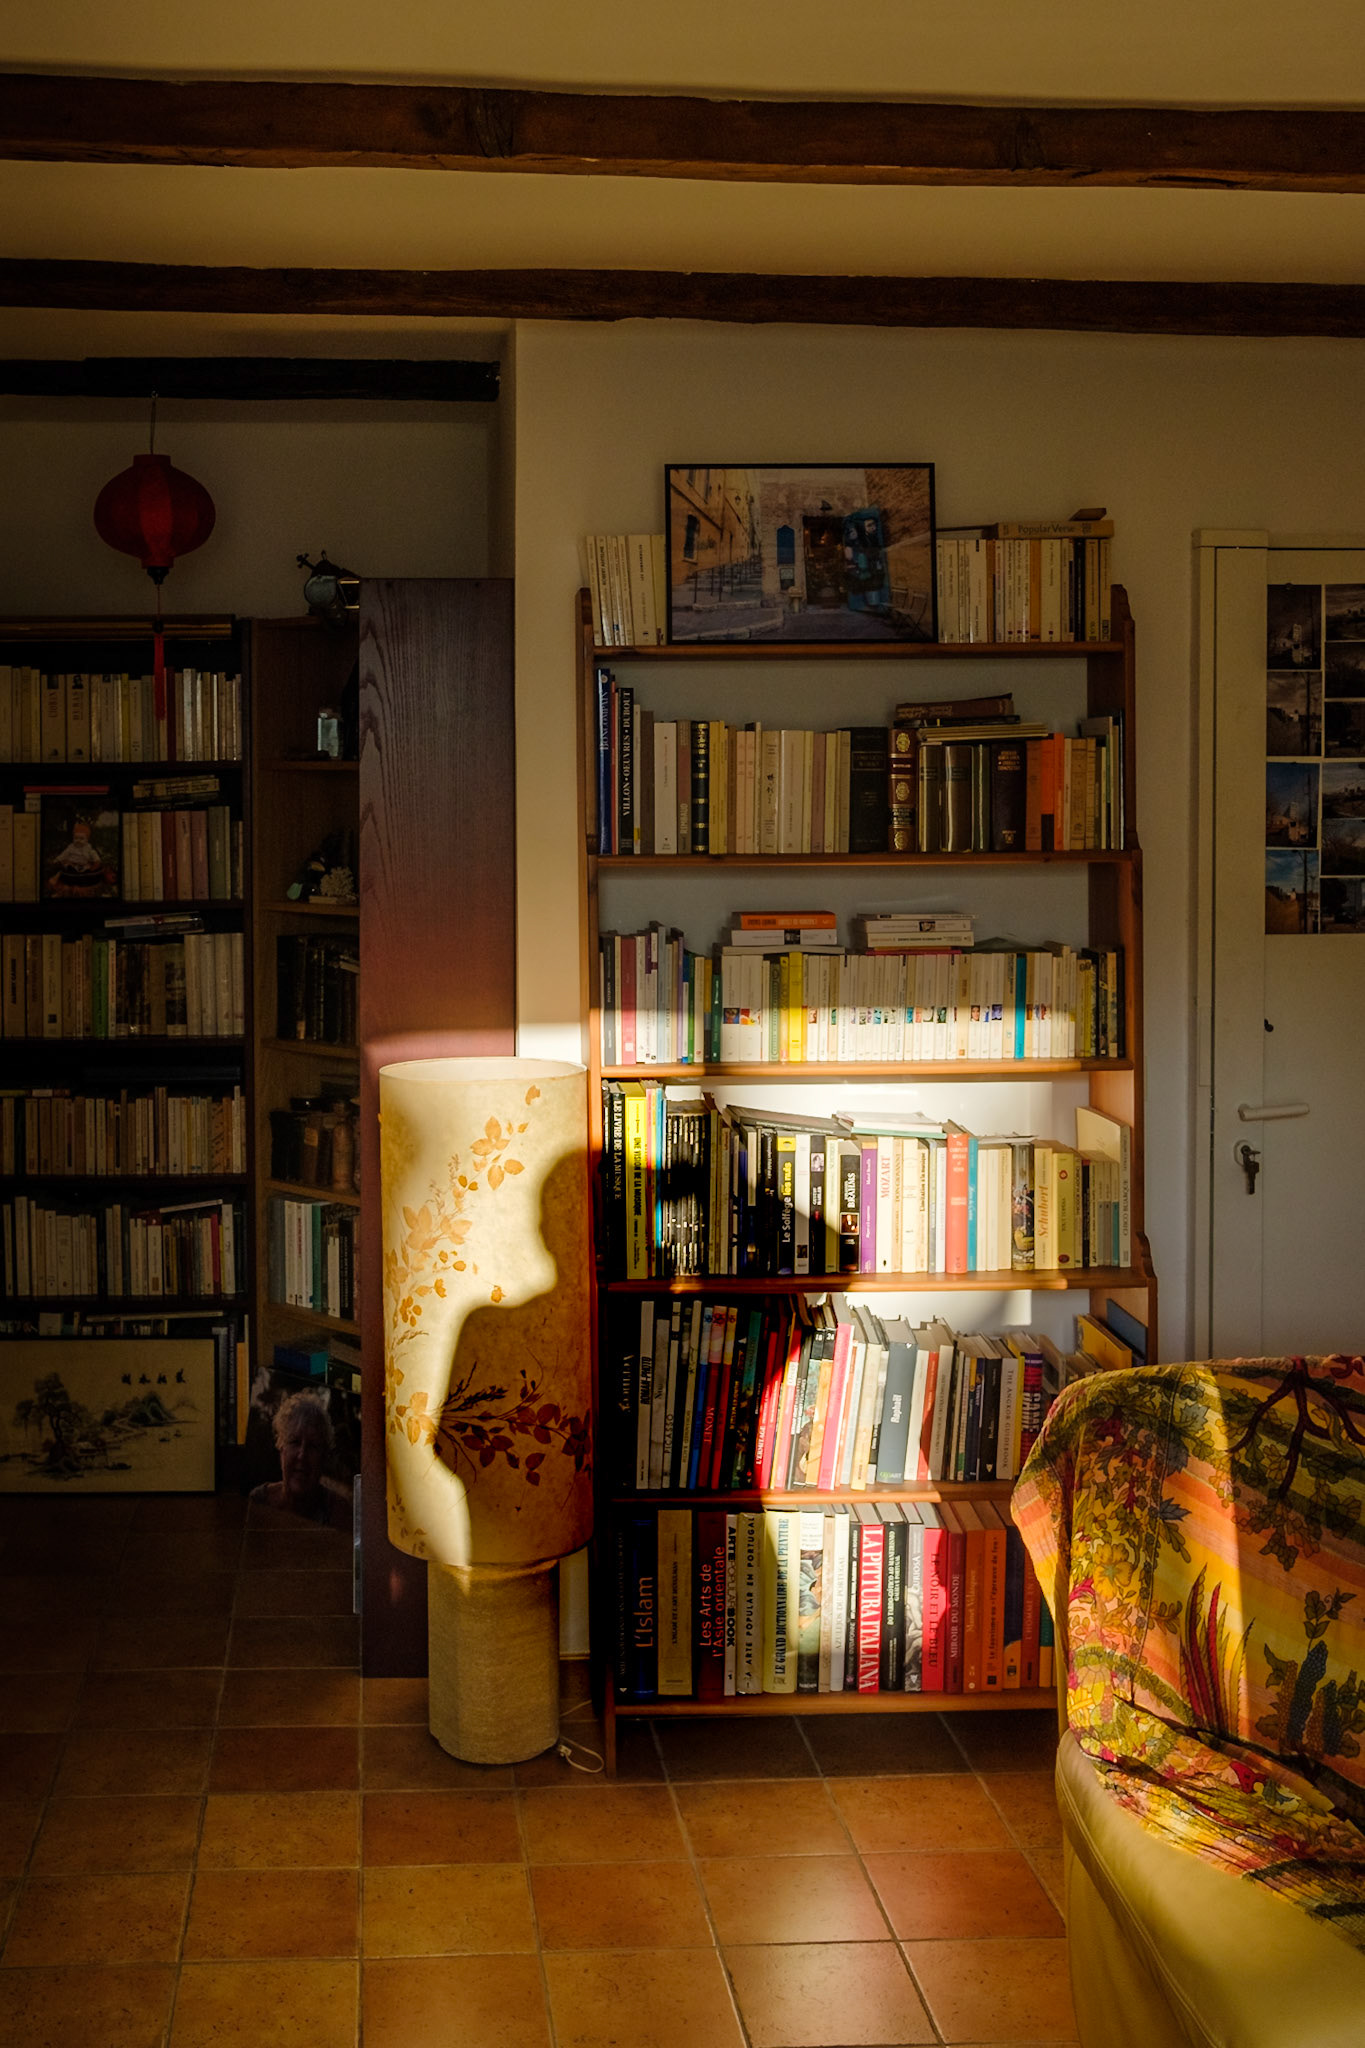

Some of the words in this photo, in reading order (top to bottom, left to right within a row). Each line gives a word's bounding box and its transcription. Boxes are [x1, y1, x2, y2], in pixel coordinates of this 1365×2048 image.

[1018, 525, 1050, 535] Popular
[600, 690, 609, 750] BONCOMPAIN
[622, 691, 632, 728] DUBOUT
[622, 735, 632, 777] OEUVRES
[622, 782, 632, 816] VILLON
[613, 1100, 623, 1112] LE
[613, 1113, 622, 1139] LIVRE
[613, 1139, 622, 1151] DE
[613, 1152, 622, 1163] LA
[633, 1137, 642, 1150] UNE
[633, 1151, 642, 1170] VISION
[633, 1171, 642, 1180] DE
[782, 1162, 791, 1181] nuls
[613, 1164, 622, 1200] MUSIQUE
[633, 1180, 642, 1188] LA
[783, 1181, 791, 1196] les
[846, 1172, 856, 1209] BRAHMS
[880, 1156, 891, 1199] MOZART
[632, 1188, 642, 1216] MUSIQUE
[781, 1196, 793, 1231] Solfège
[1037, 1184, 1049, 1239] Schubert
[782, 1232, 791, 1243] Le
[826, 1332, 835, 1341] 24
[891, 1393, 903, 1424] Raphaël
[1005, 1386, 1013, 1420] ANGKOR
[664, 1414, 673, 1454] PICASSO
[703, 1406, 715, 1446] MONET
[1003, 1422, 1011, 1469] GUIDEBOOK
[727, 1526, 736, 1561] ARTE
[746, 1518, 755, 1568] PORTUGAL
[778, 1518, 789, 1556] PEINTURE
[862, 1527, 883, 1548] LA
[699, 1563, 712, 1582] de
[777, 1559, 788, 1568] LA
[930, 1553, 940, 1564] LE
[712, 1546, 724, 1612] orientale
[747, 1574, 754, 1587] EM
[777, 1570, 787, 1581] DE
[837, 1556, 846, 1597] PORTUGAL
[861, 1551, 883, 1622] PITTURA
[930, 1570, 941, 1599] NOIR
[950, 1573, 960, 1610] MONDE
[632, 1576, 654, 1648] L'Islam
[699, 1585, 712, 1618] Arts
[746, 1592, 754, 1636] POPULAR
[776, 1581, 787, 1635] DICTIONNAIRE
[929, 1605, 940, 1615] ET
[950, 1610, 958, 1623] DU
[699, 1621, 712, 1647] Les
[727, 1608, 735, 1648] BOOK
[835, 1612, 844, 1651] AZULEJOS
[929, 1621, 939, 1633] LE
[988, 1617, 996, 1650] fauvisme
[1025, 1600, 1033, 1641] L'HOMME
[712, 1617, 724, 1658] l'Asie
[775, 1637, 787, 1664] GRAND
[928, 1638, 939, 1668] BLEU
[950, 1624, 959, 1659] MIROIR
[775, 1666, 786, 1675] LE
[859, 1622, 881, 1689] ITALIANA
[989, 1651, 995, 1660] Le
